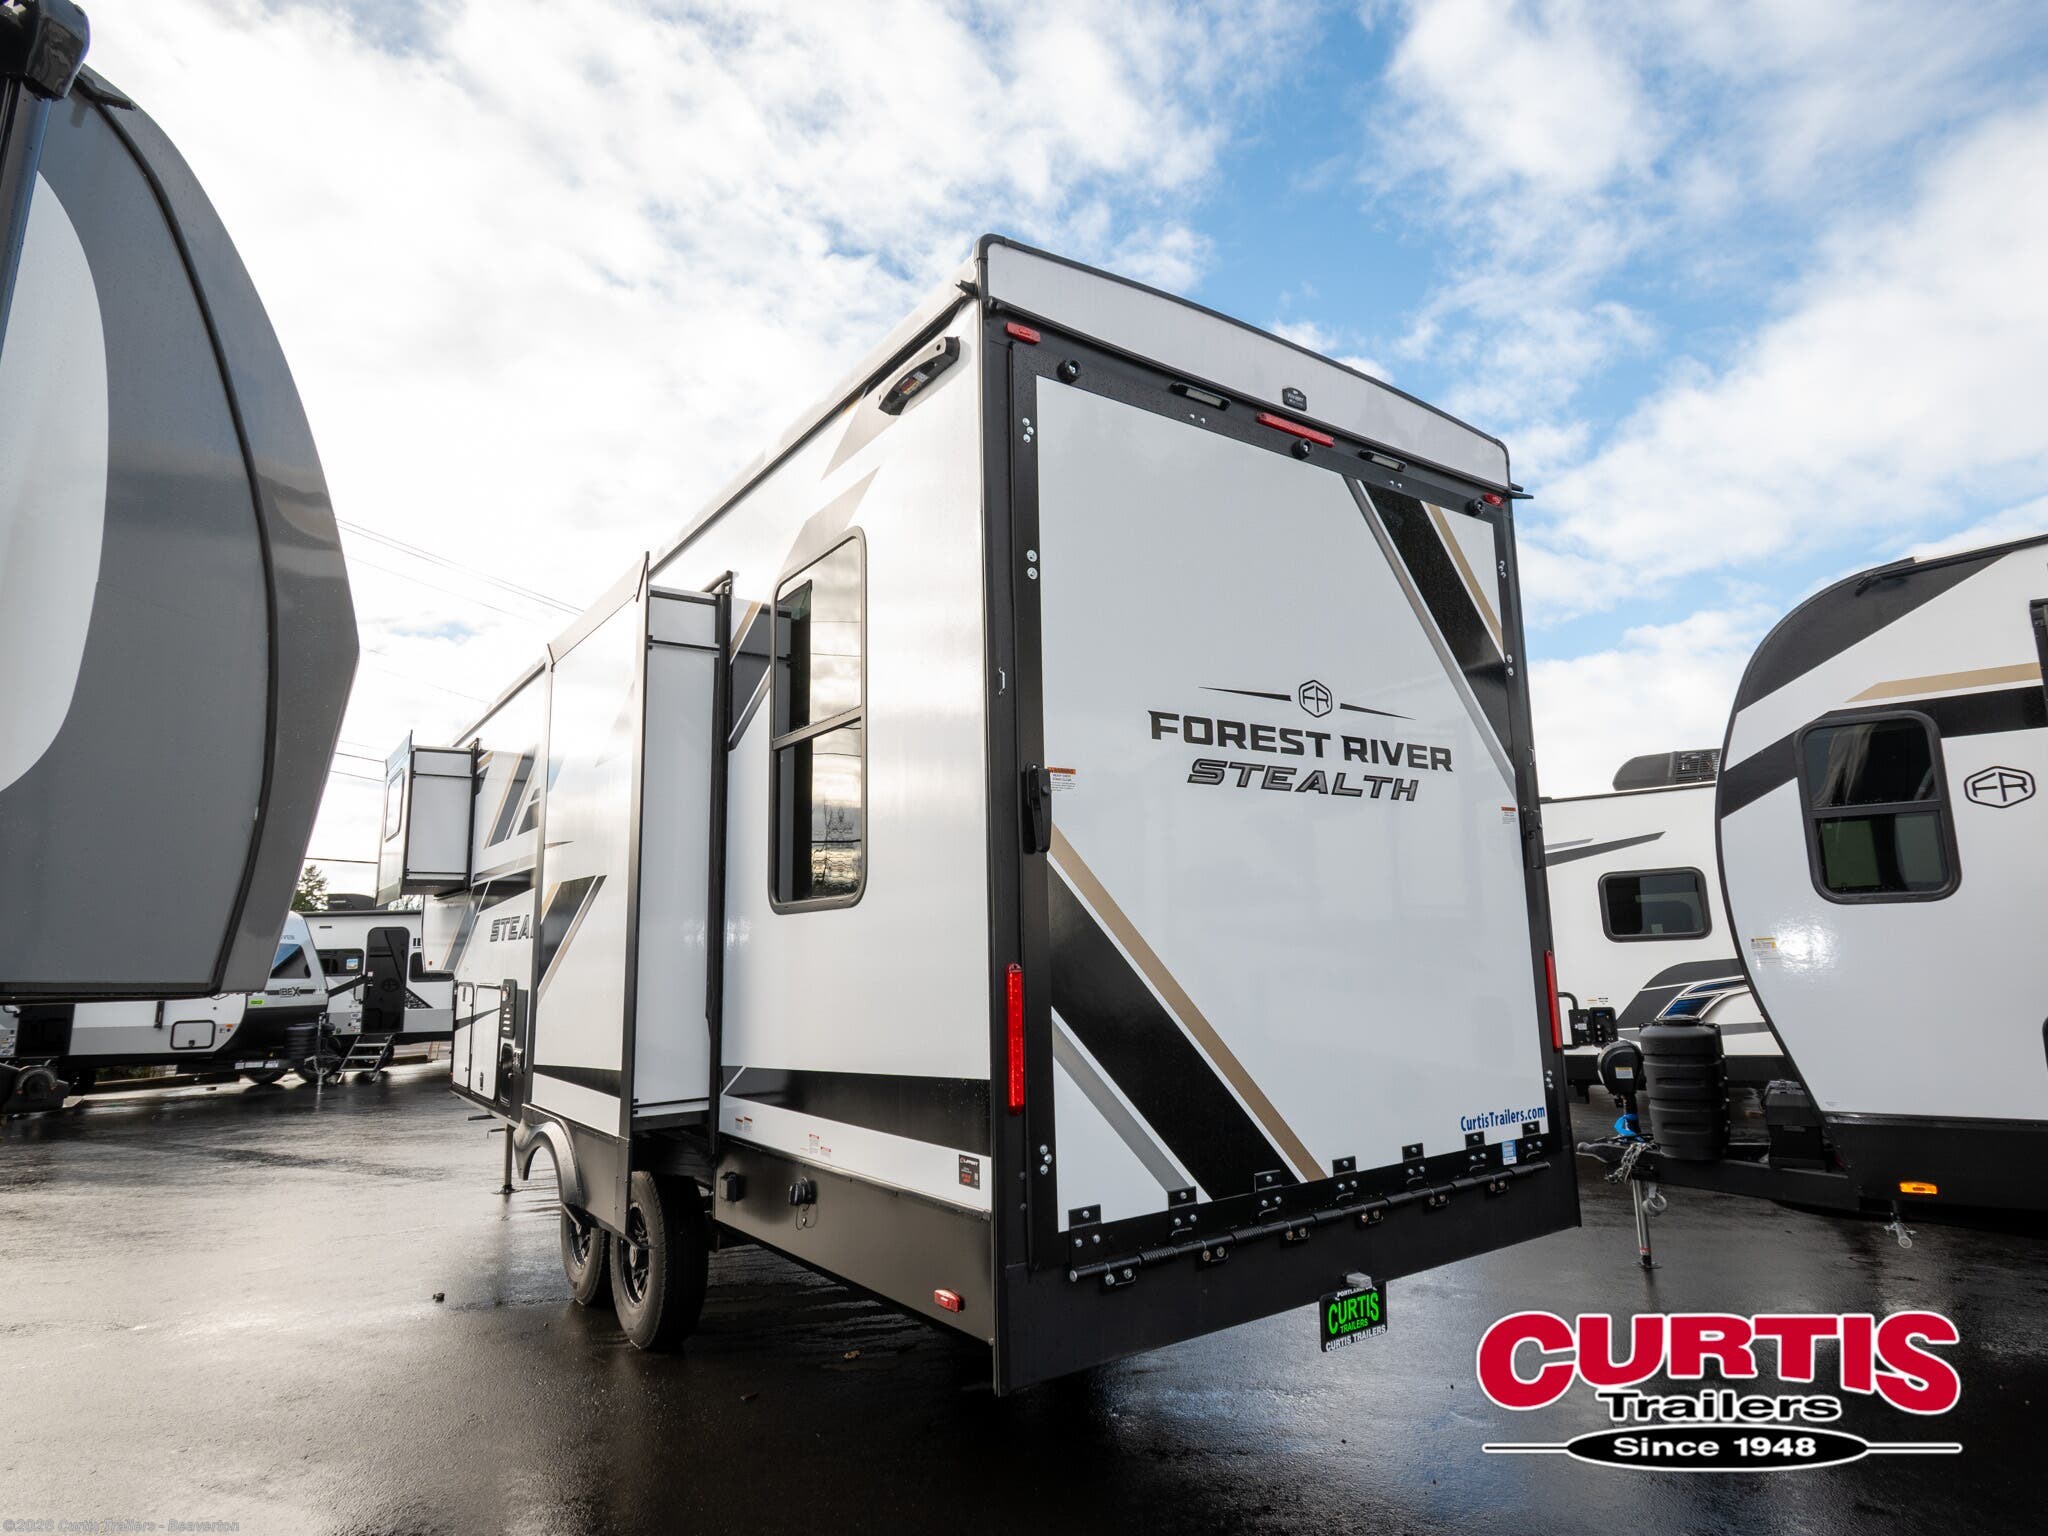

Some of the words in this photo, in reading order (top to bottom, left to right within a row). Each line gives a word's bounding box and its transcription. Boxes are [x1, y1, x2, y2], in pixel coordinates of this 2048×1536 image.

[1147, 710, 1331, 758] FOREST
[1340, 735, 1454, 773] RIVER
[1187, 758, 1419, 802] STEALTH
[489, 914, 534, 943] STEA
[1460, 1106, 1546, 1132] CurtisTrailers.com
[1328, 1292, 1379, 1335] CURTIS
[1340, 1318, 1369, 1334] TRAILERS
[1325, 1335, 1352, 1352] CURTIS
[1352, 1324, 1386, 1342] TRAILERS
